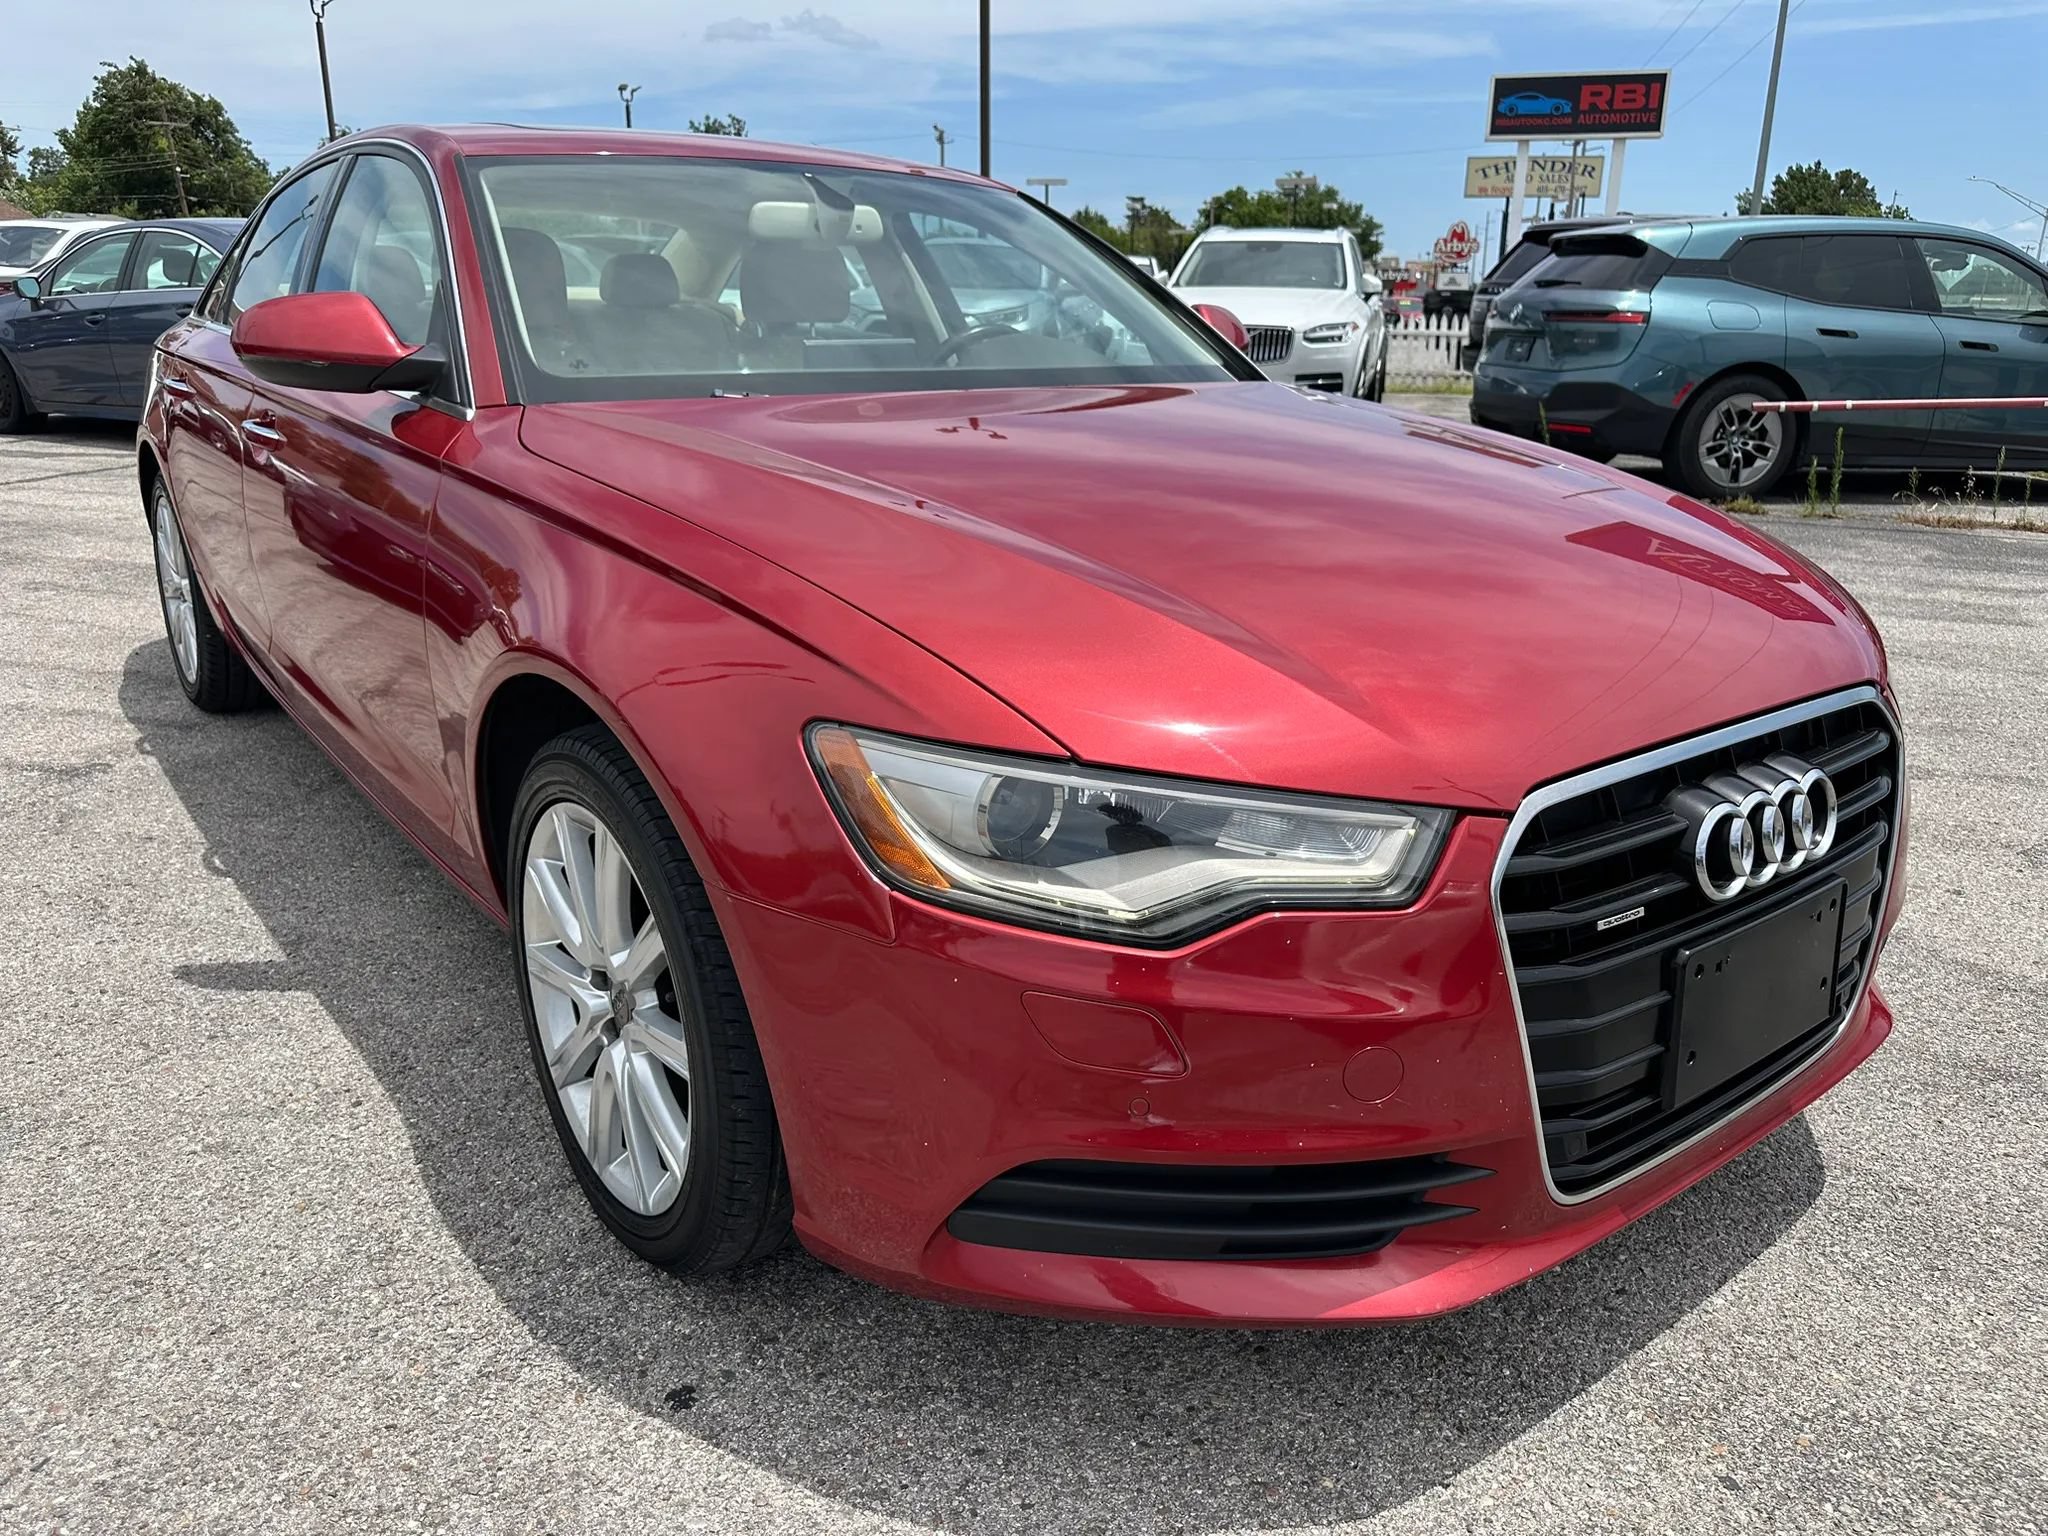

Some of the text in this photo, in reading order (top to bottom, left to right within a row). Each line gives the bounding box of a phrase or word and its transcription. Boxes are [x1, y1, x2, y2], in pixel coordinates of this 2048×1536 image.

[1580, 83, 1661, 110] RBI
[1578, 112, 1657, 125] AUTOMOTIVE
[1436, 239, 1478, 256] Arby's
[1376, 270, 1410, 283] Arby's
[1603, 910, 1641, 927] quattro
